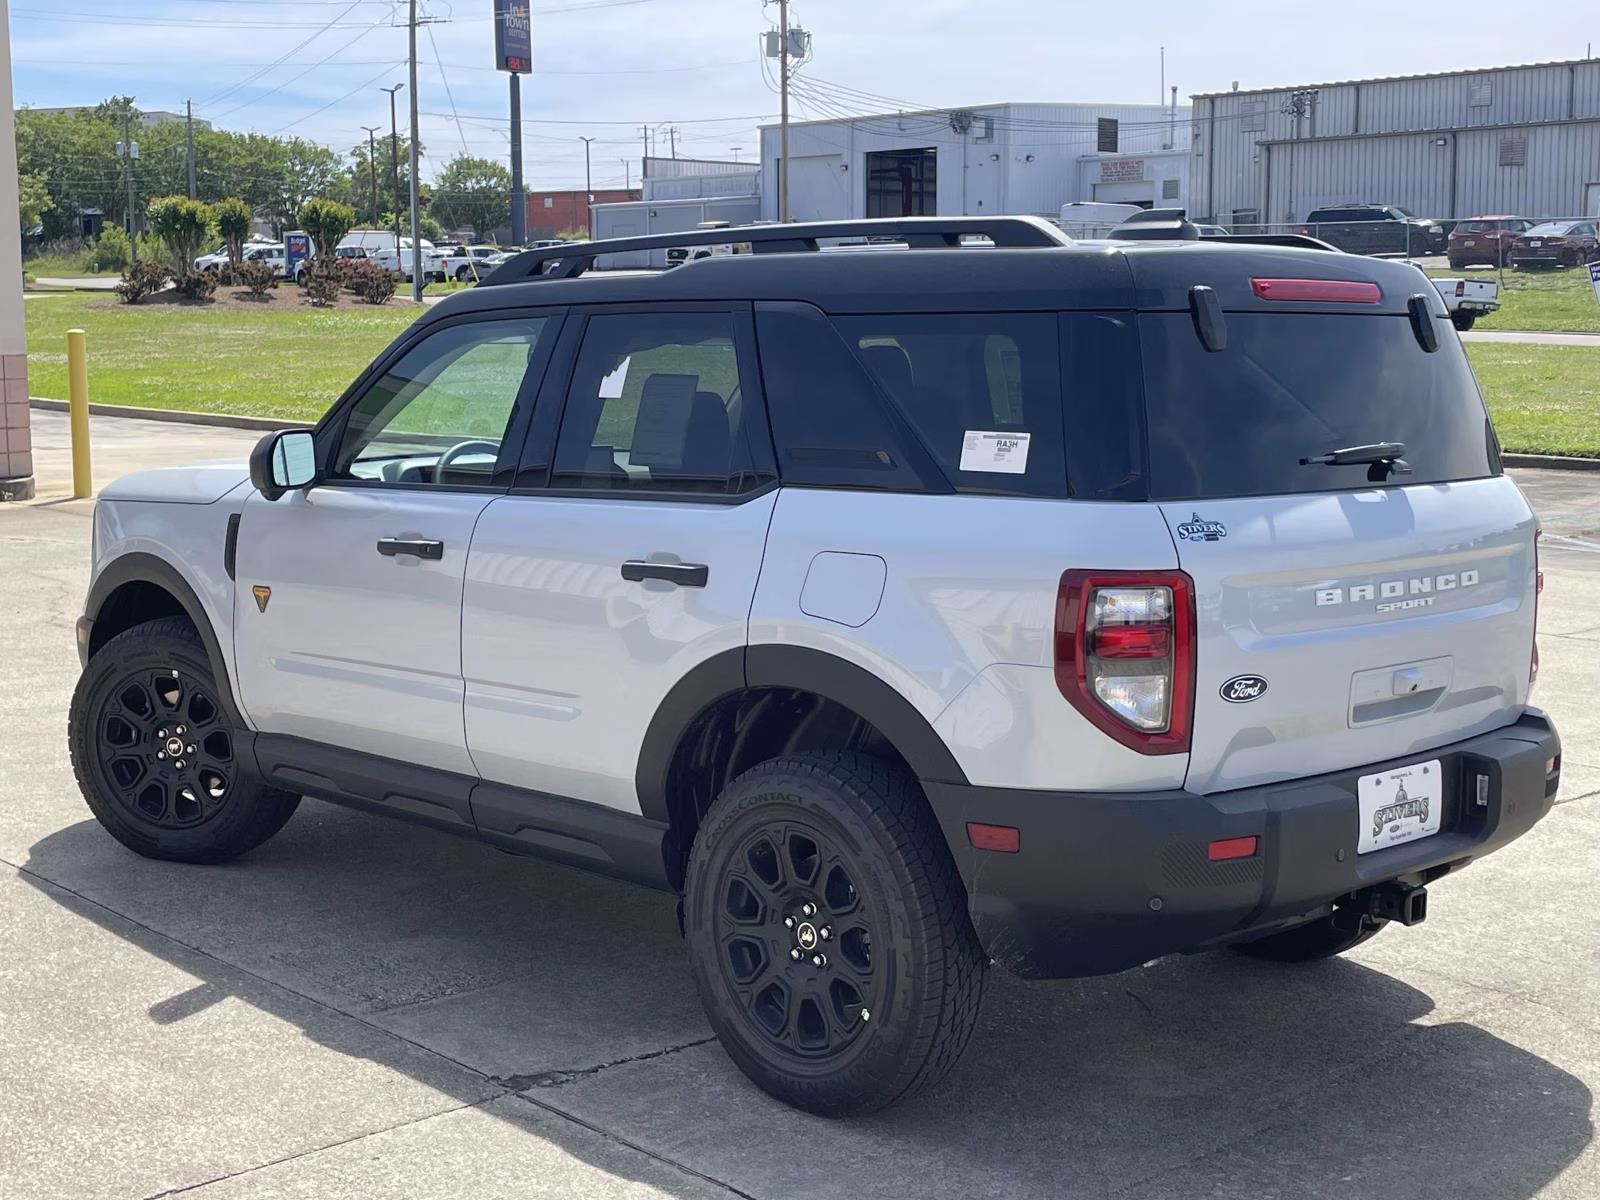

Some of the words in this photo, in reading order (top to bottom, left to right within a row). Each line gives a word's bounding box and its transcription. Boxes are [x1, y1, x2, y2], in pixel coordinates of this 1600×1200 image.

[504, 13, 529, 31] Town
[1178, 523, 1227, 540] STIVERS
[1315, 570, 1479, 606] BRONCO
[1375, 597, 1437, 613] SPORT
[1230, 680, 1262, 698] Ford
[1373, 797, 1430, 838] STIVERS
